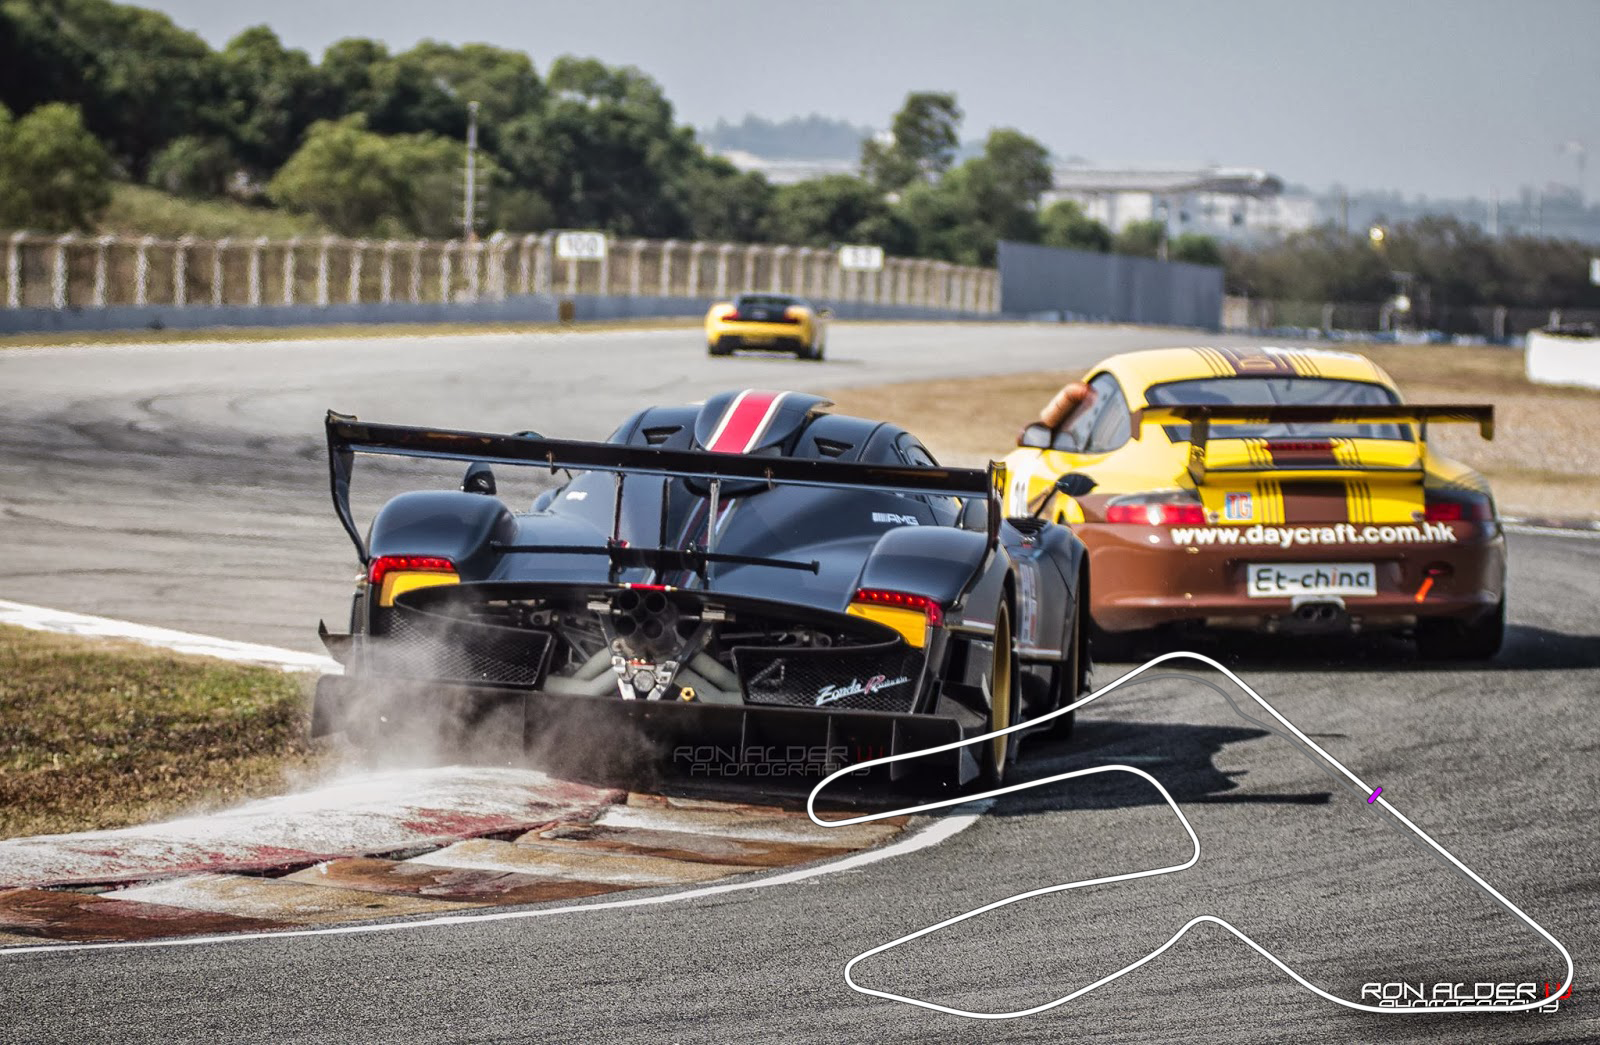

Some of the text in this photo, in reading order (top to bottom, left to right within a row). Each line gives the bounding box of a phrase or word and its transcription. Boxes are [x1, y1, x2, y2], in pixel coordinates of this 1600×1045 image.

[887, 513, 919, 526] AMG
[1171, 523, 1457, 549] www.daycraft.com.hk
[1255, 567, 1371, 590] Et-china
